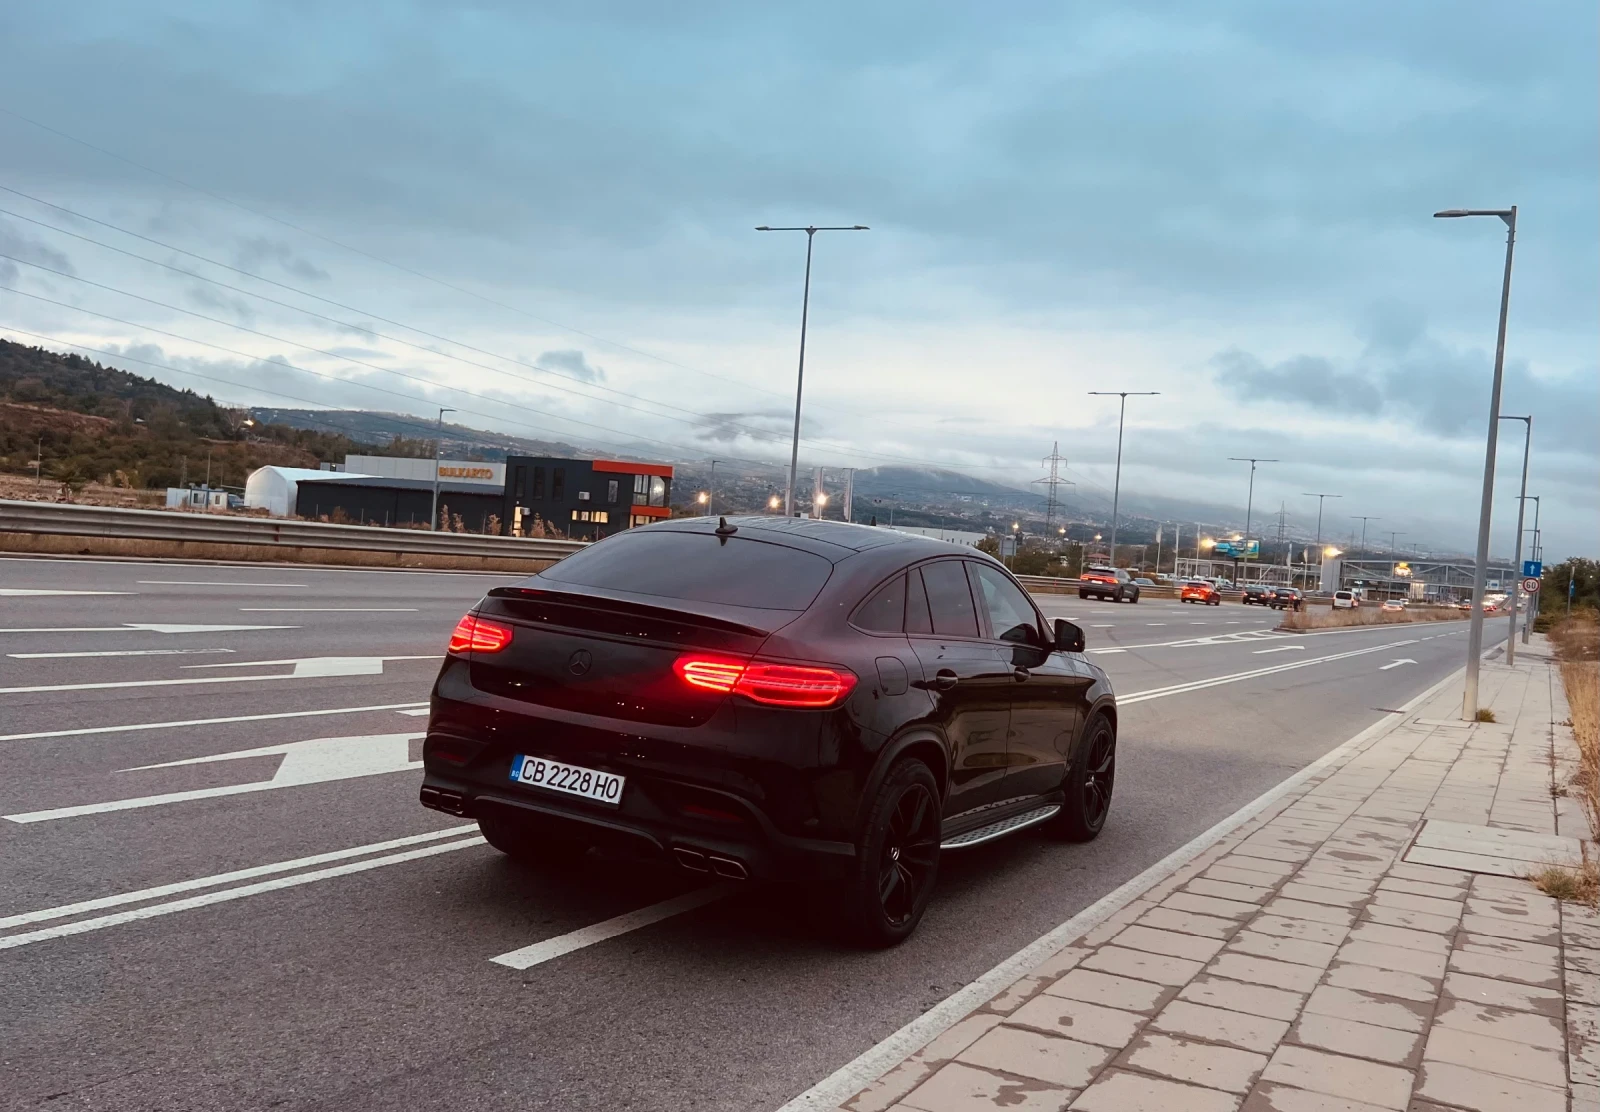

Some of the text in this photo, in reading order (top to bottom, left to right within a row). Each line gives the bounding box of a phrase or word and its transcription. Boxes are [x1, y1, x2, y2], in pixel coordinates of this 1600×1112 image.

[1526, 581, 1536, 589] 60
[511, 769, 520, 778] BG
[522, 759, 546, 783] CB
[546, 765, 592, 793] 2228
